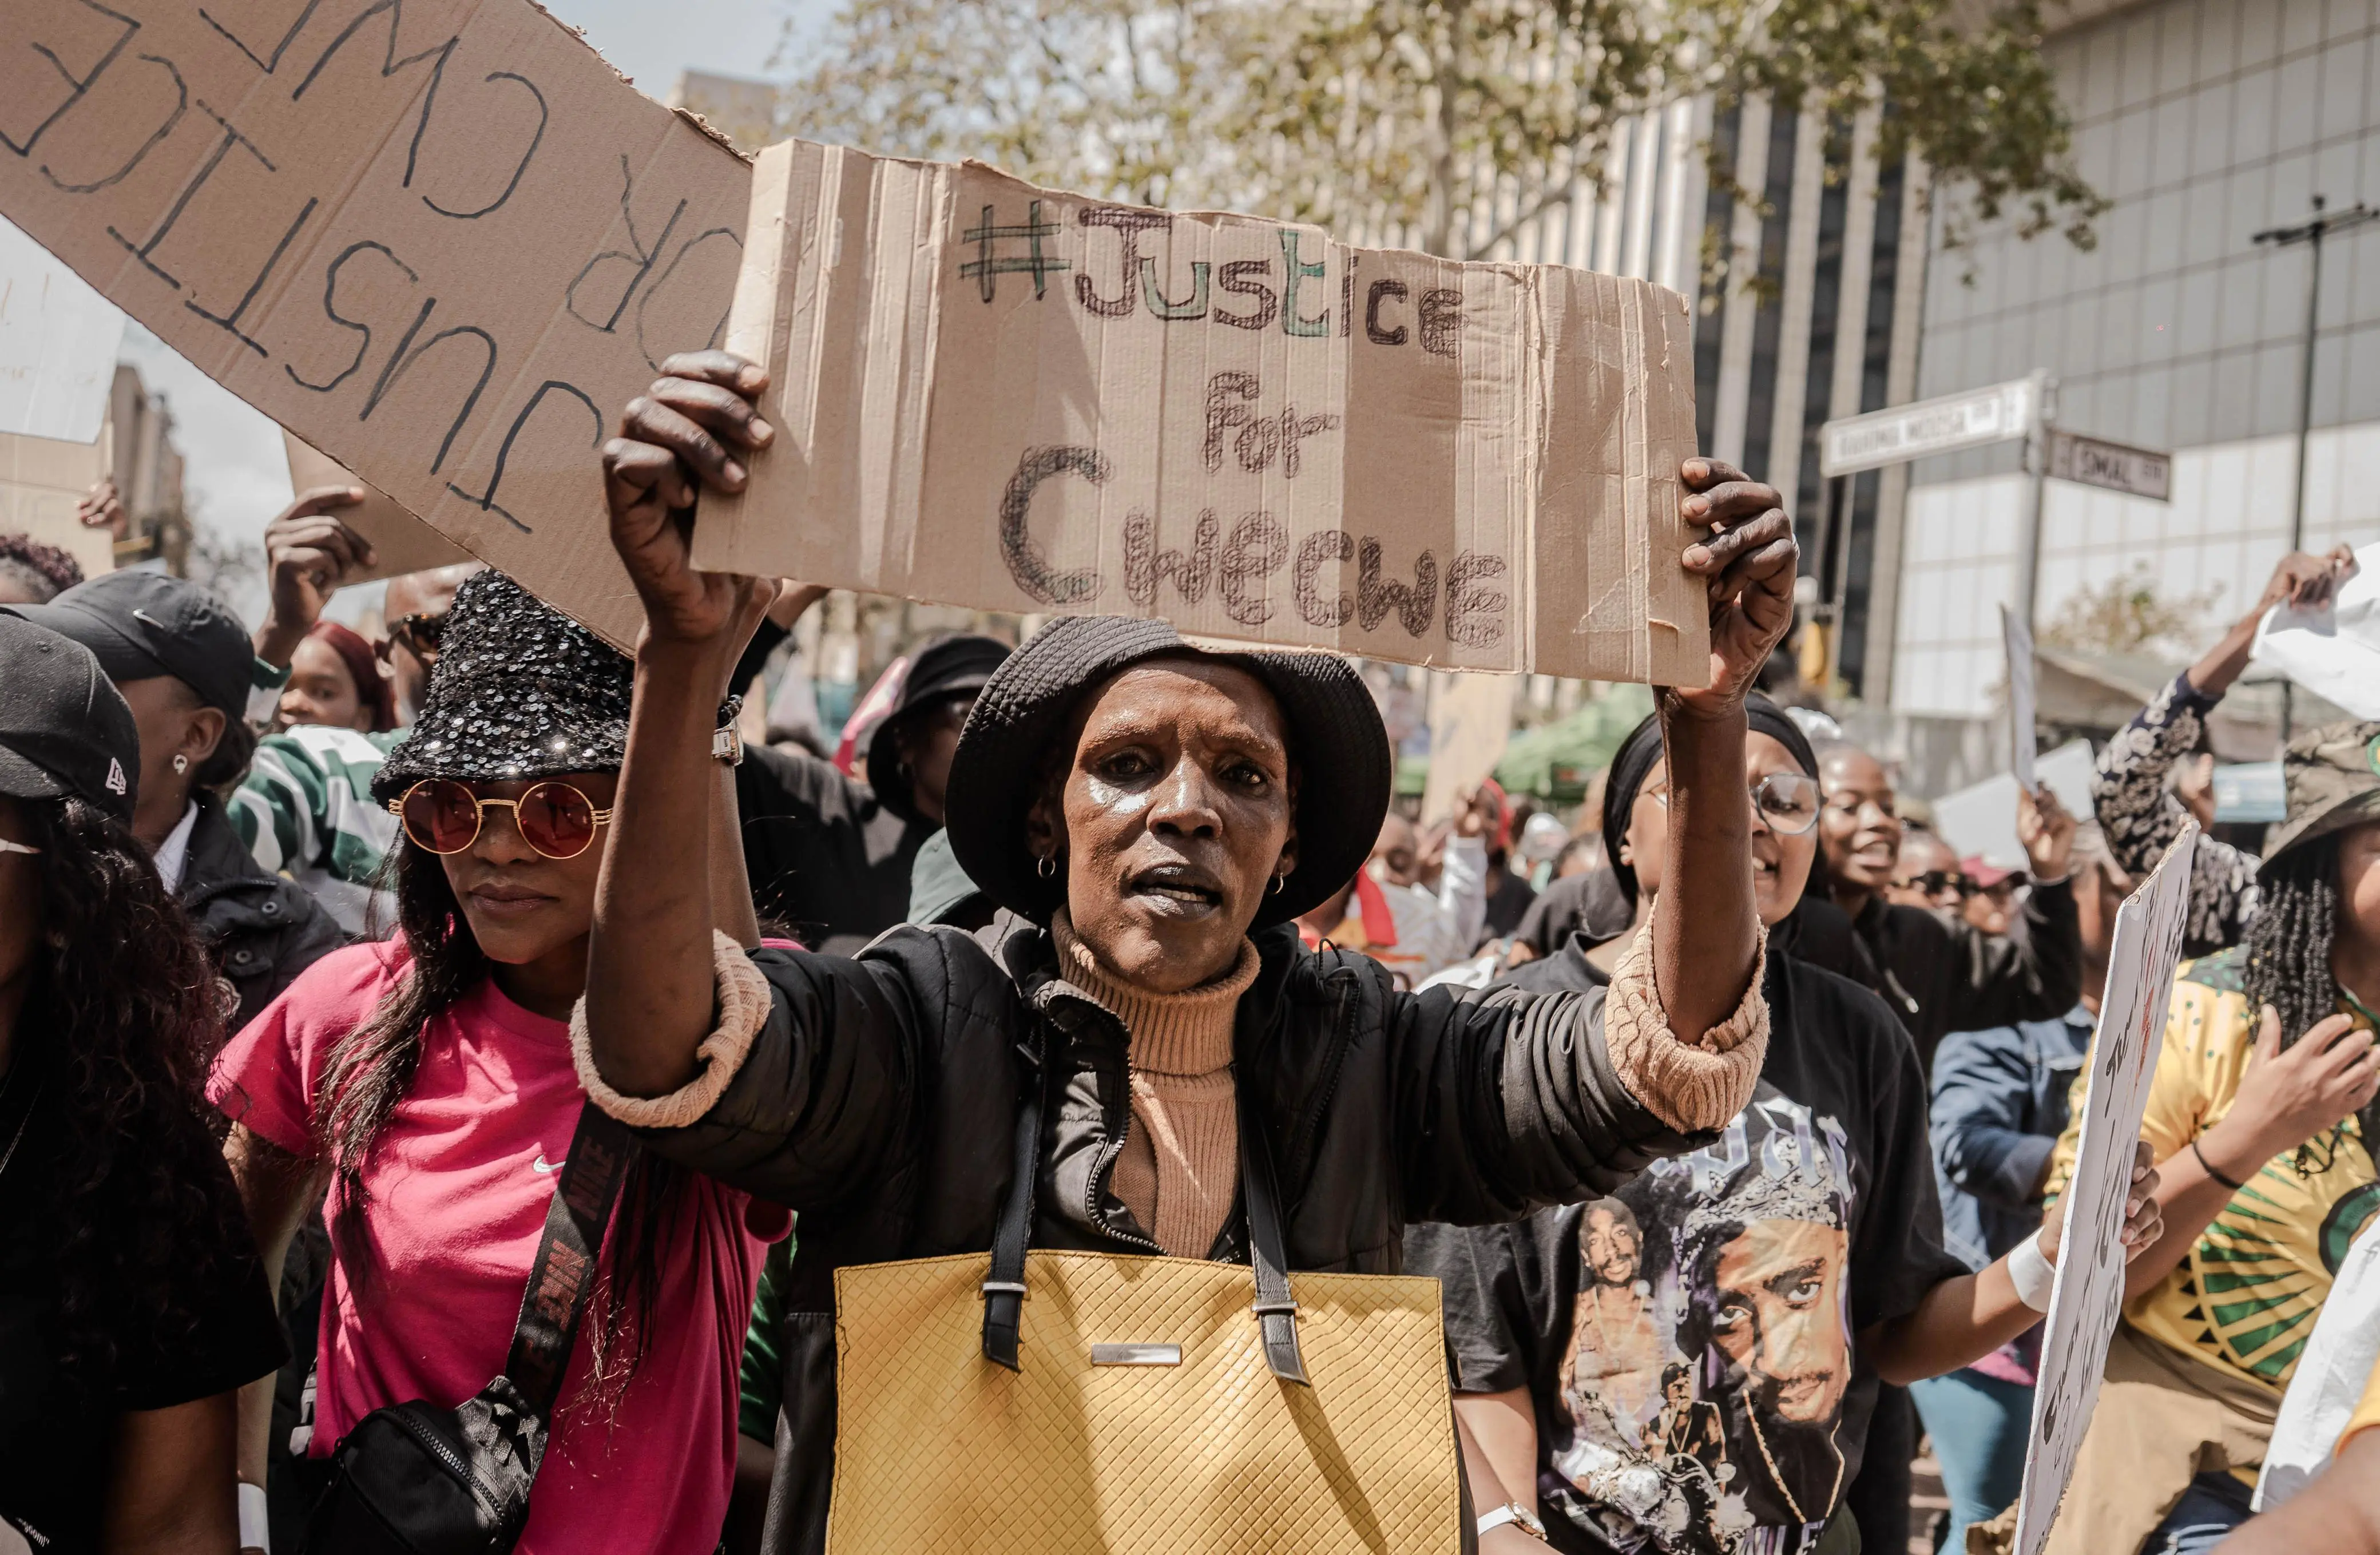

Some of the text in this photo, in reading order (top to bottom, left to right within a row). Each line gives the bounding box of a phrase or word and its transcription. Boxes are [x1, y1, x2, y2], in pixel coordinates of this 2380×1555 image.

[568, 152, 745, 371] OR
[565, 1136, 615, 1222] NIKE
[535, 1237, 587, 1332] NIKE
